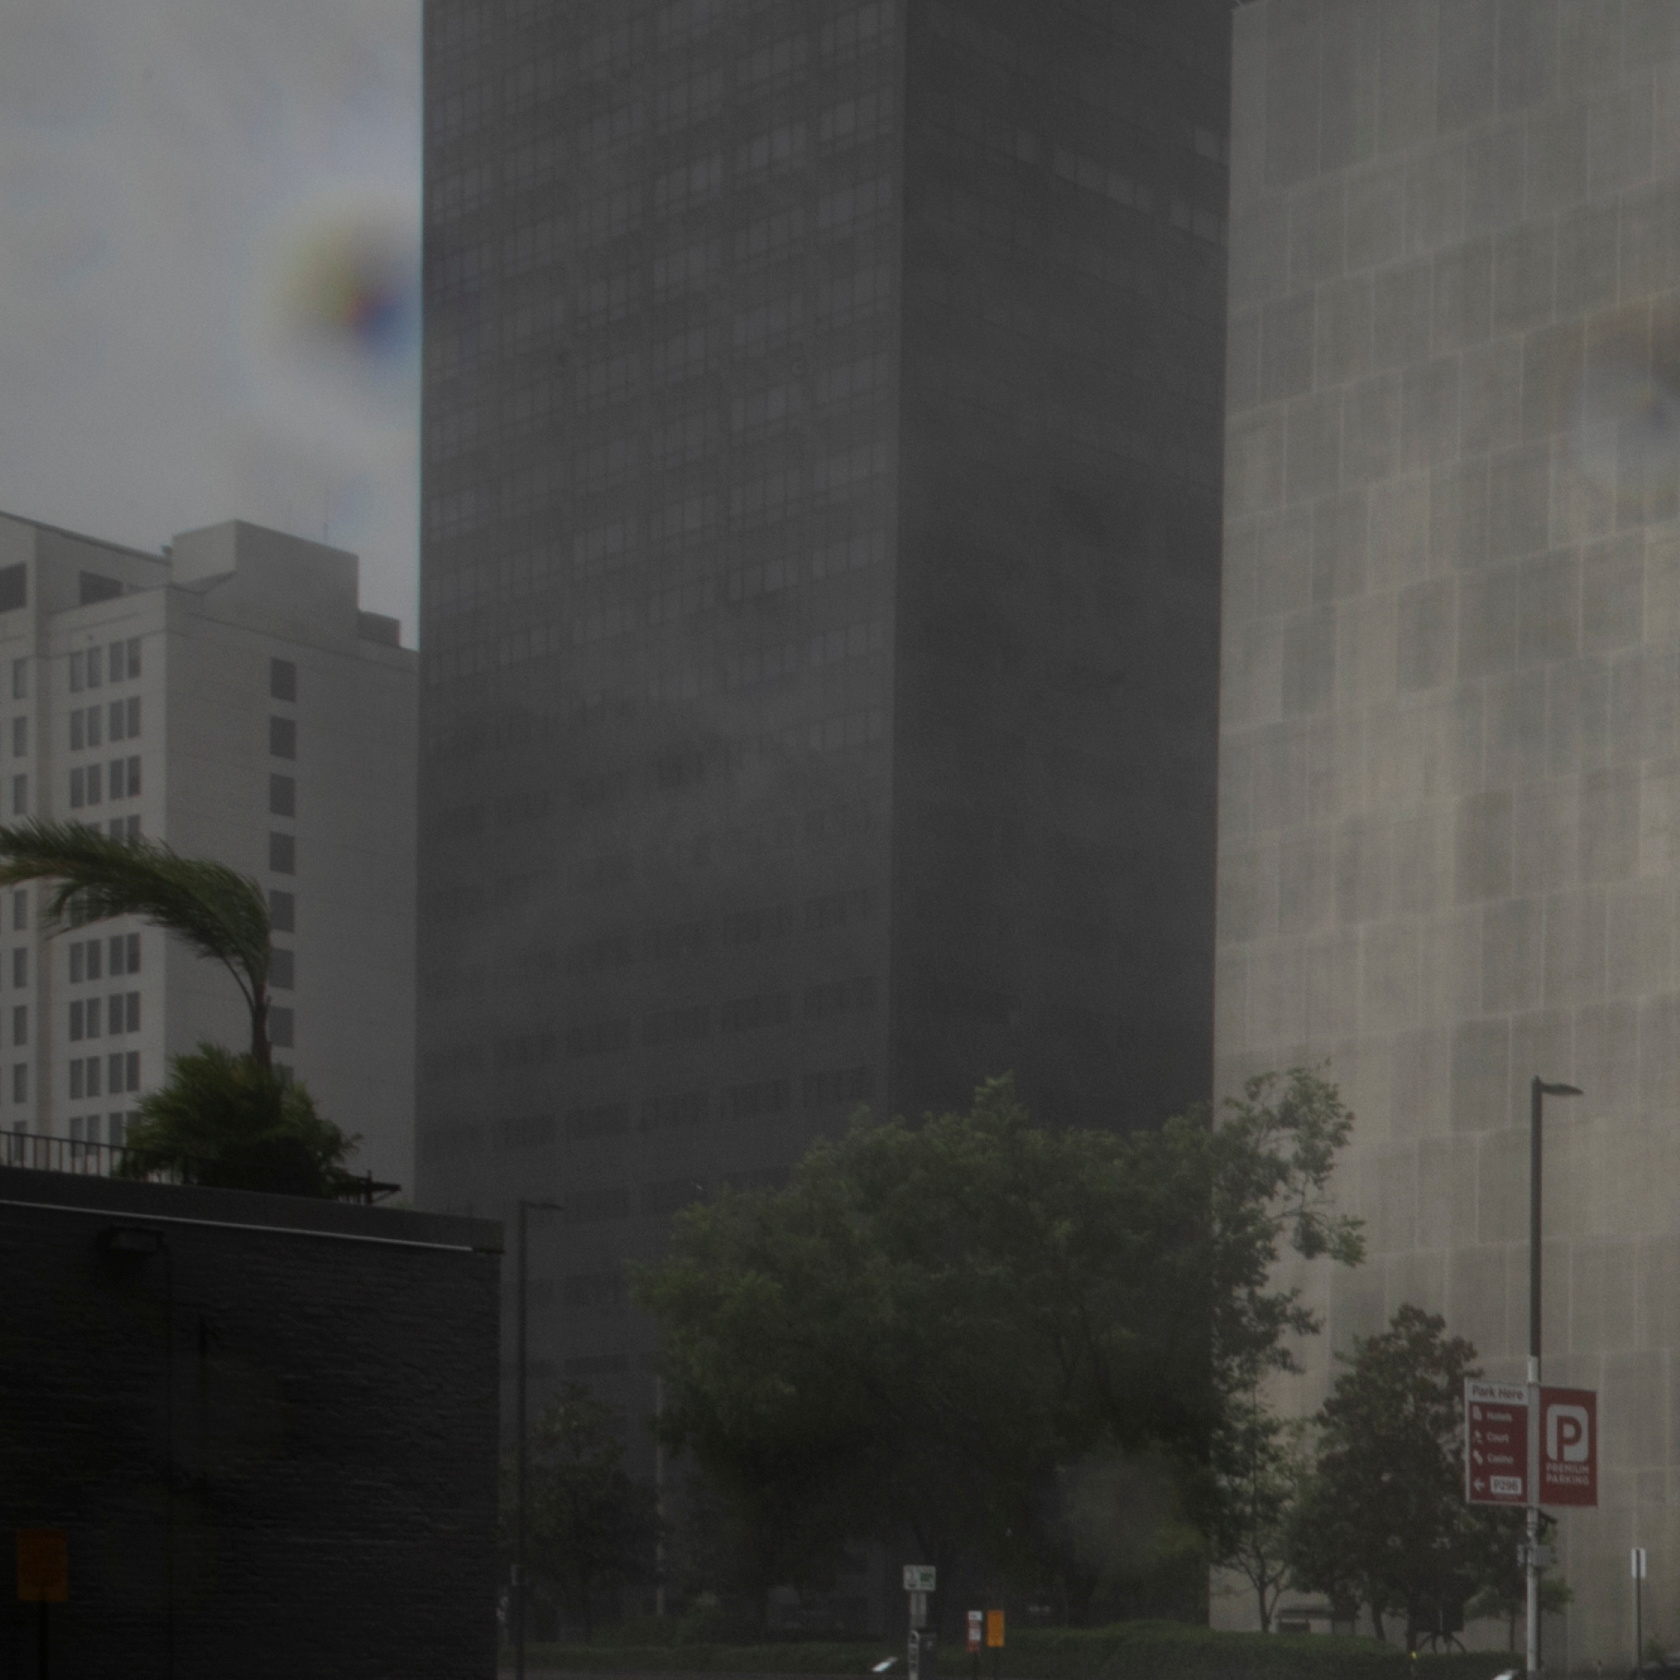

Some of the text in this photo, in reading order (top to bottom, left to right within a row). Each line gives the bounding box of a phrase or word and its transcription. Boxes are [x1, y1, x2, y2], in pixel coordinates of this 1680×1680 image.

[1472, 1385, 1523, 1399] Park Here
[1546, 1463, 1589, 1474] PREMIUM
[1546, 1474, 1589, 1485] PARKING
